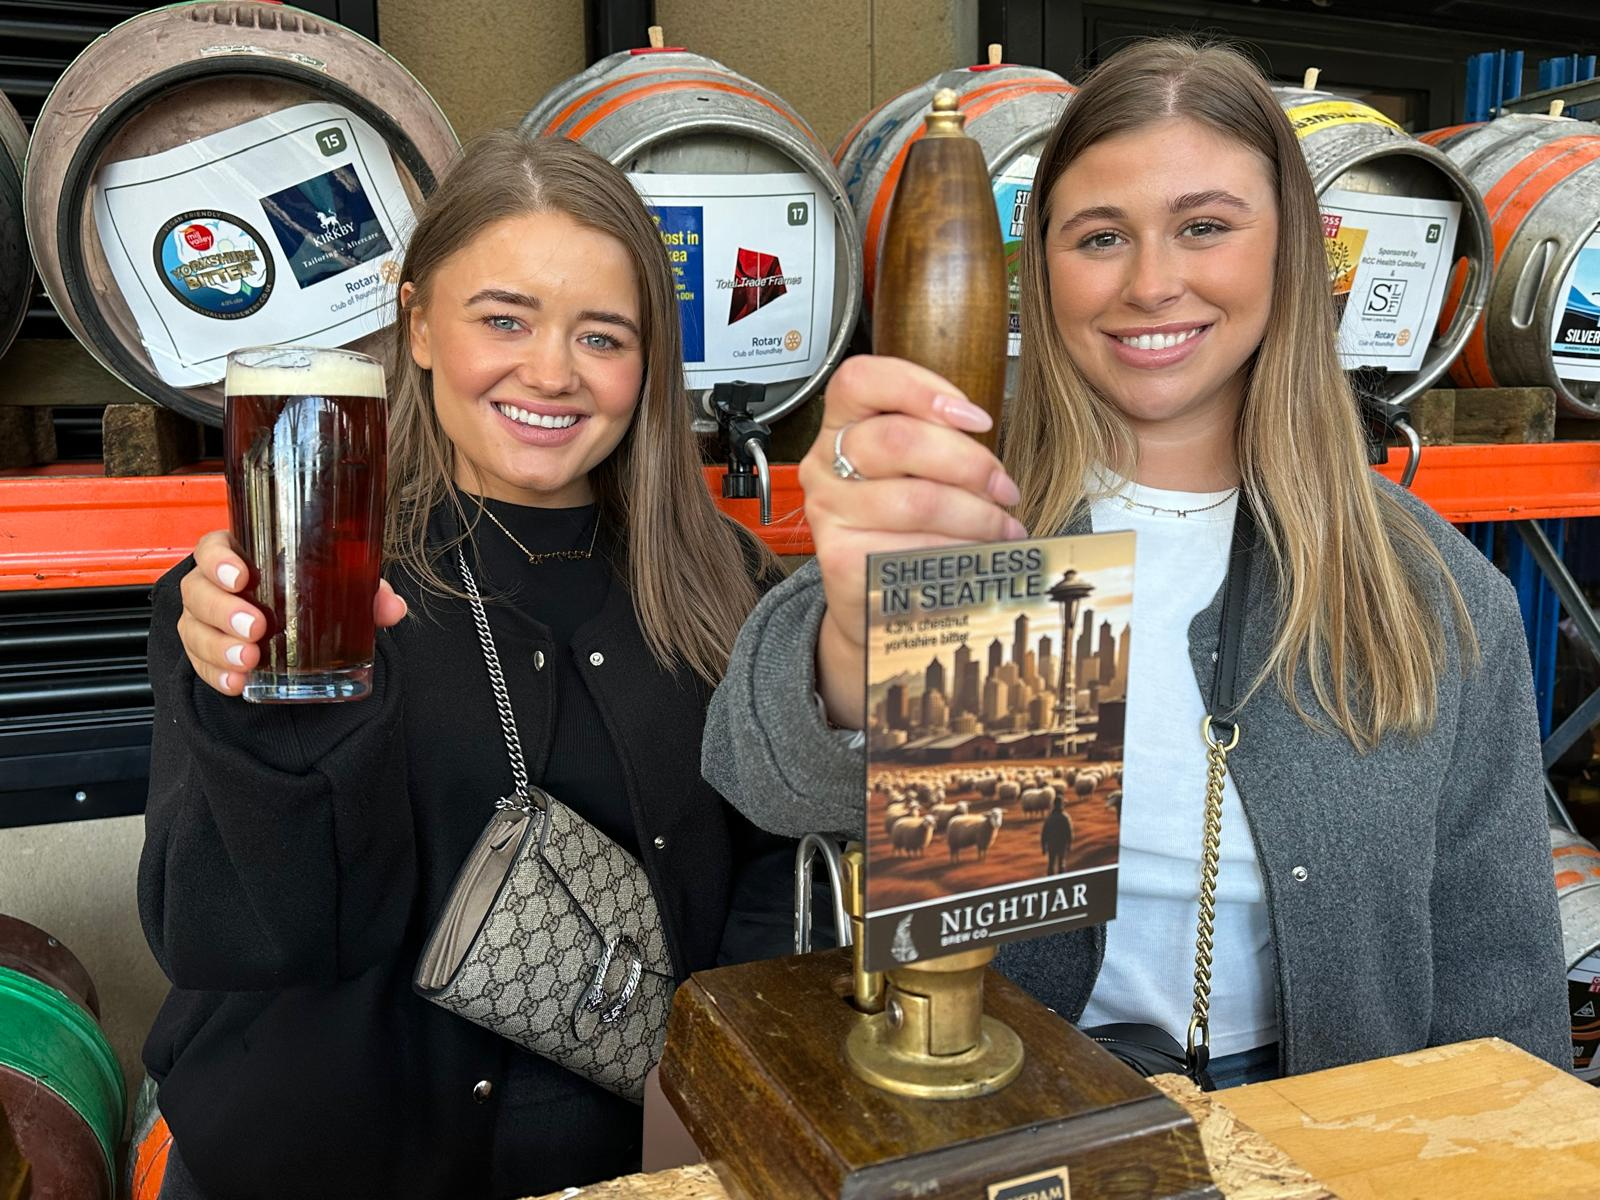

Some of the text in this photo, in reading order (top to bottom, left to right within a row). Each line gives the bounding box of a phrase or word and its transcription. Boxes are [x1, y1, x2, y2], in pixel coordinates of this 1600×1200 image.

[322, 134, 340, 149] 15
[163, 211, 221, 232] VEGAN FRIENDLY
[792, 208, 804, 220] 17
[313, 222, 355, 247] KIRKBY
[687, 230, 699, 245] in
[1428, 228, 1438, 239] 21
[189, 235, 212, 249] valley
[302, 232, 379, 268] Tailoring Aftercare
[1379, 248, 1418, 258] Sponsored by
[170, 249, 260, 280] YORKSHIRE
[1376, 258, 1396, 266] Health
[1397, 260, 1426, 269] Consulting
[184, 261, 257, 291] BITTER
[345, 272, 380, 293] Rotary
[716, 275, 802, 290] Total Trade Frames
[330, 300, 347, 312] Club
[347, 296, 355, 306] of
[752, 336, 782, 347] Rotary
[1374, 330, 1396, 341] Rotary
[1565, 329, 1600, 344] SILVER
[732, 350, 747, 358] Club
[756, 347, 783, 356] Roundhay
[880, 548, 1042, 587] SHEEPLESS
[881, 574, 1042, 614] IN SEATTLE
[920, 614, 969, 632] chestnut
[885, 636, 938, 655] yorkshire
[940, 883, 1088, 936] NIGHTJAR
[940, 934, 971, 947] BREW
